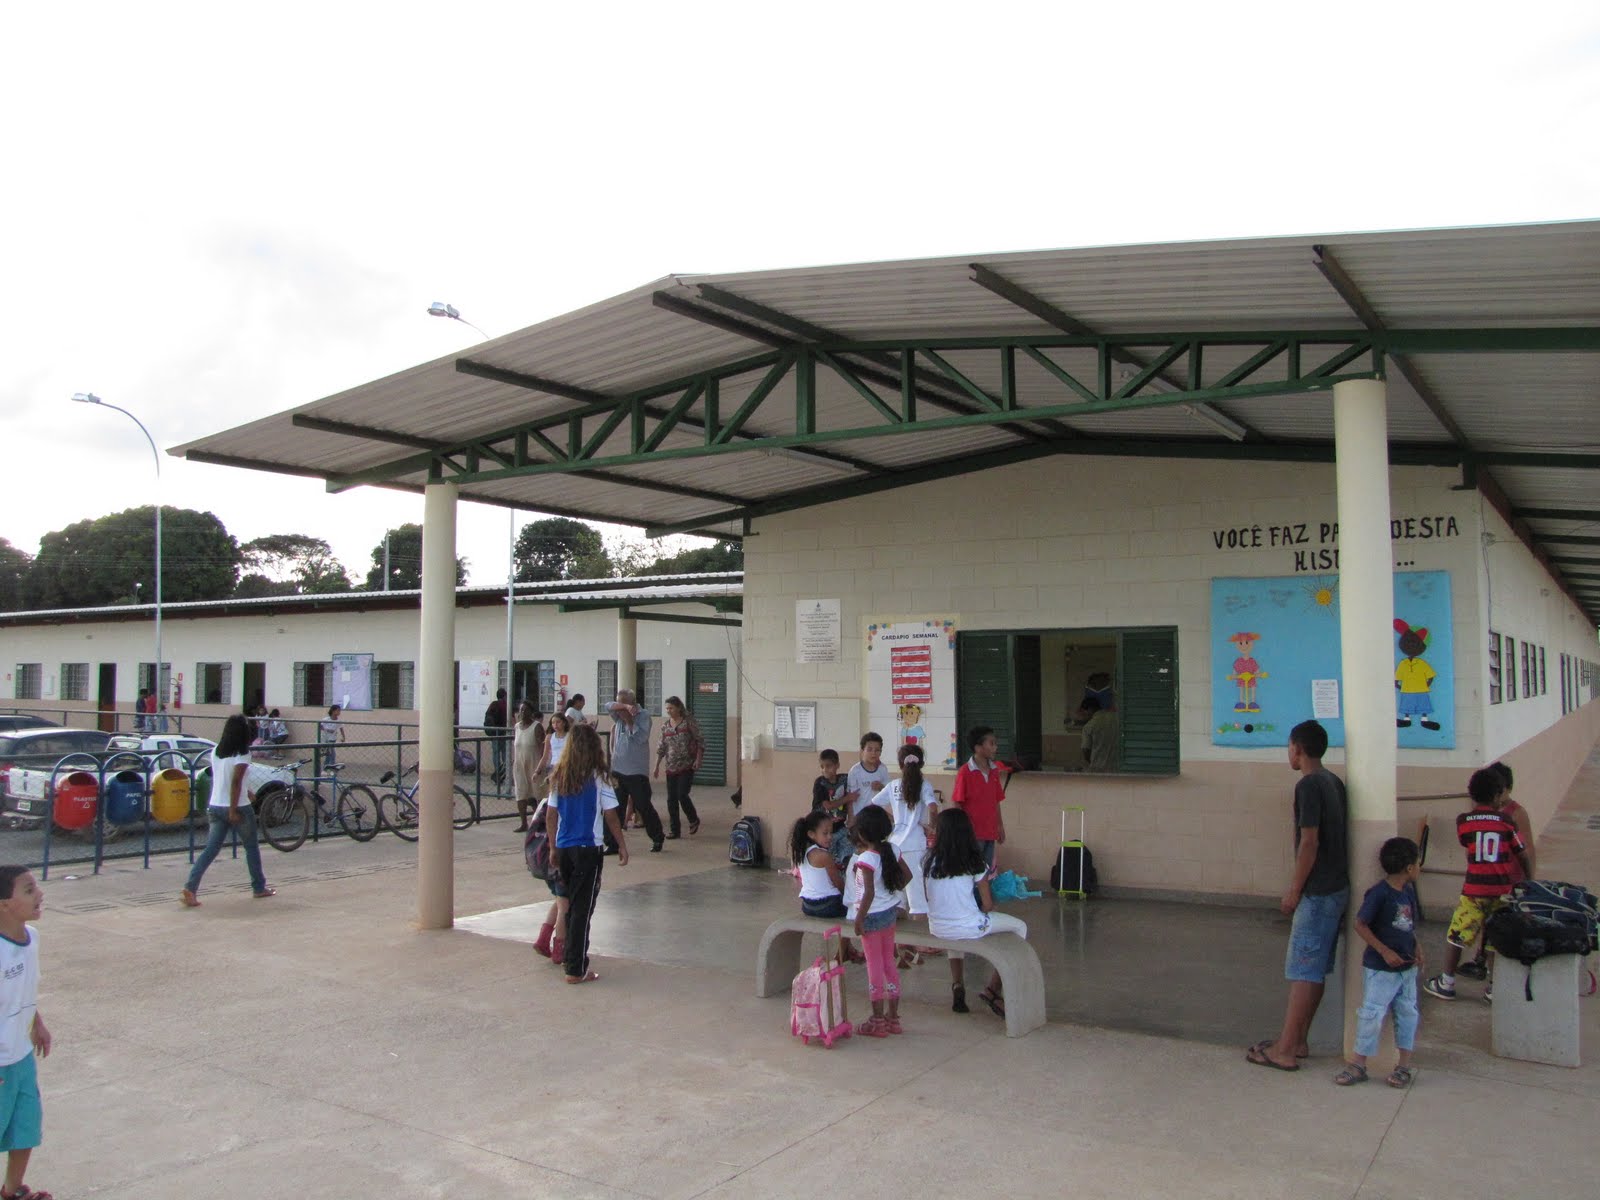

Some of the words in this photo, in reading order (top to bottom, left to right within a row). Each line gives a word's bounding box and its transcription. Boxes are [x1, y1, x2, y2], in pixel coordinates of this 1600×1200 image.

[1213, 524, 1263, 550] VOCÊ
[1269, 523, 1310, 546] FAZ
[1390, 516, 1459, 539] DESTA
[1475, 831, 1500, 863] 10
